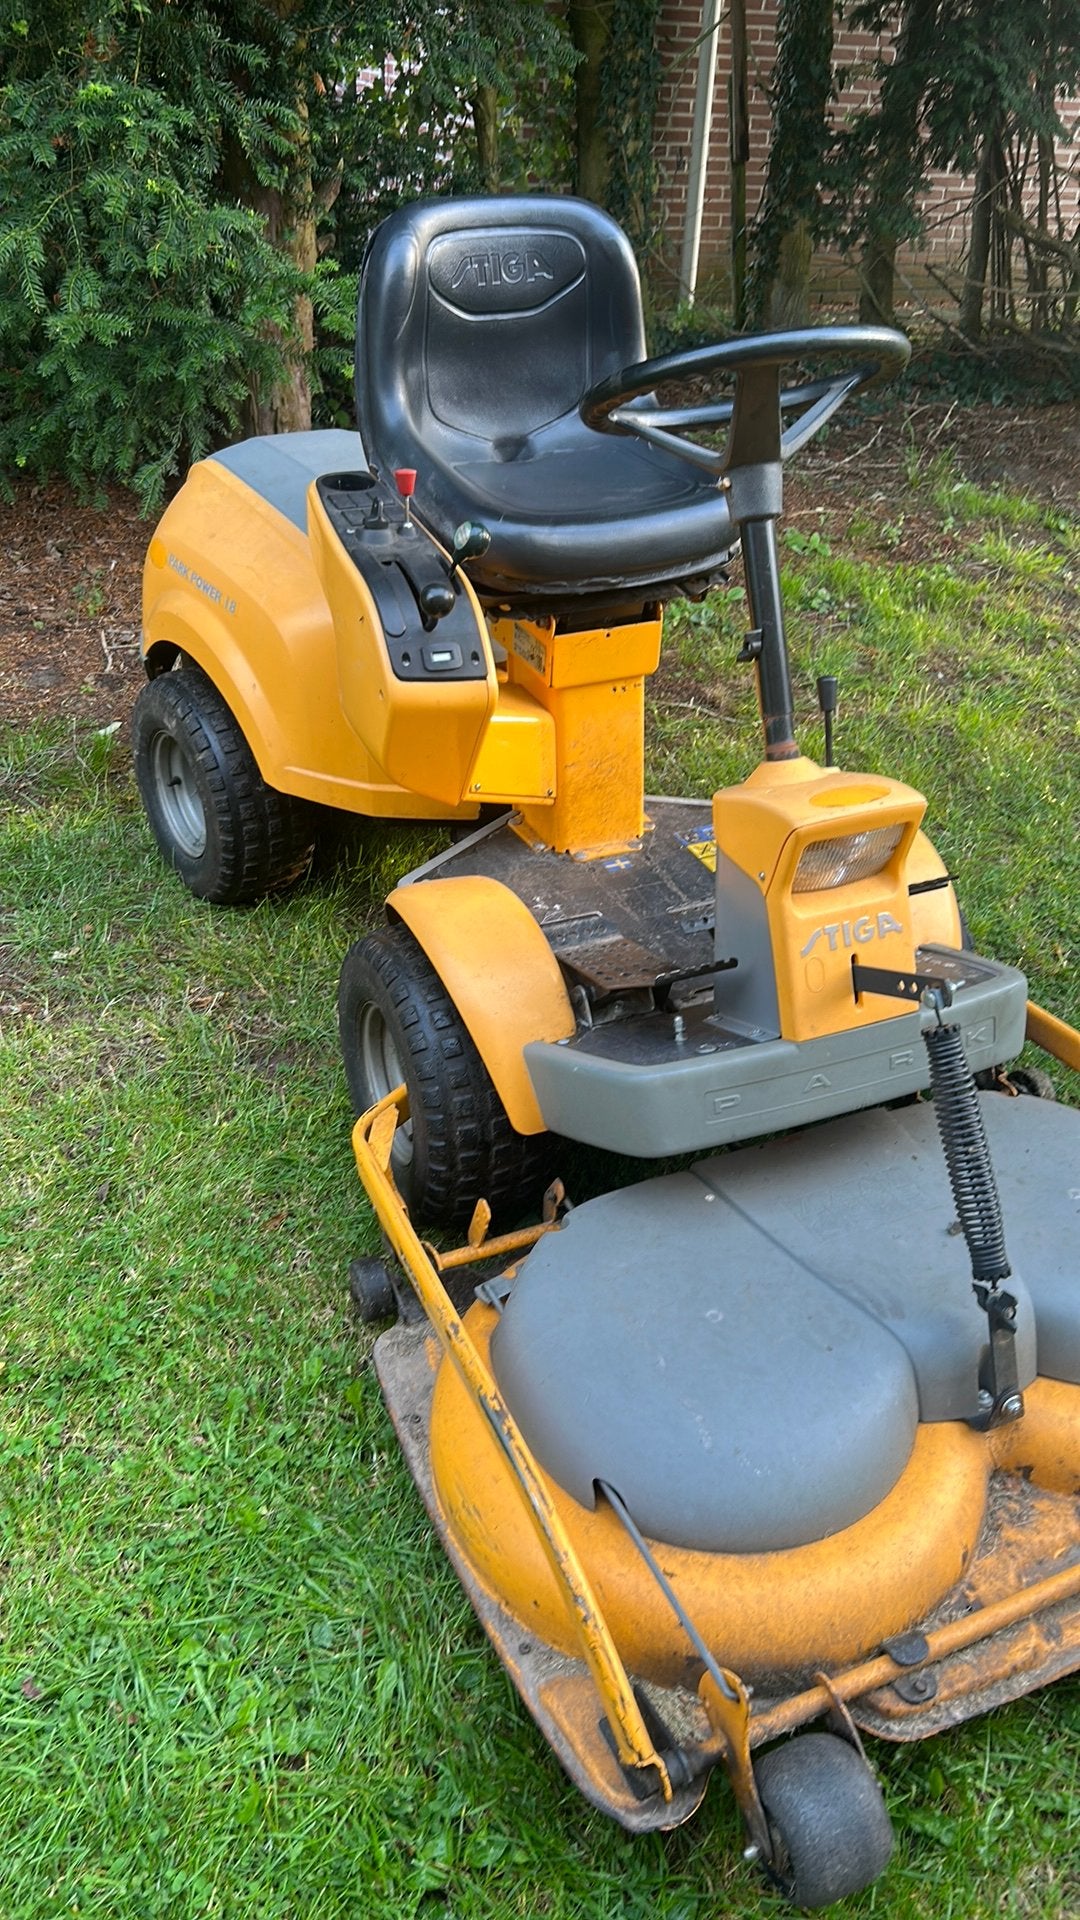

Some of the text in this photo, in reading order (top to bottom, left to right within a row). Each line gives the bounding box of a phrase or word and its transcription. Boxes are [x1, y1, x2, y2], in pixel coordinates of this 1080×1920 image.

[451, 251, 553, 289] STIGA
[190, 570, 222, 605] POWER
[800, 911, 903, 958] STIGA
